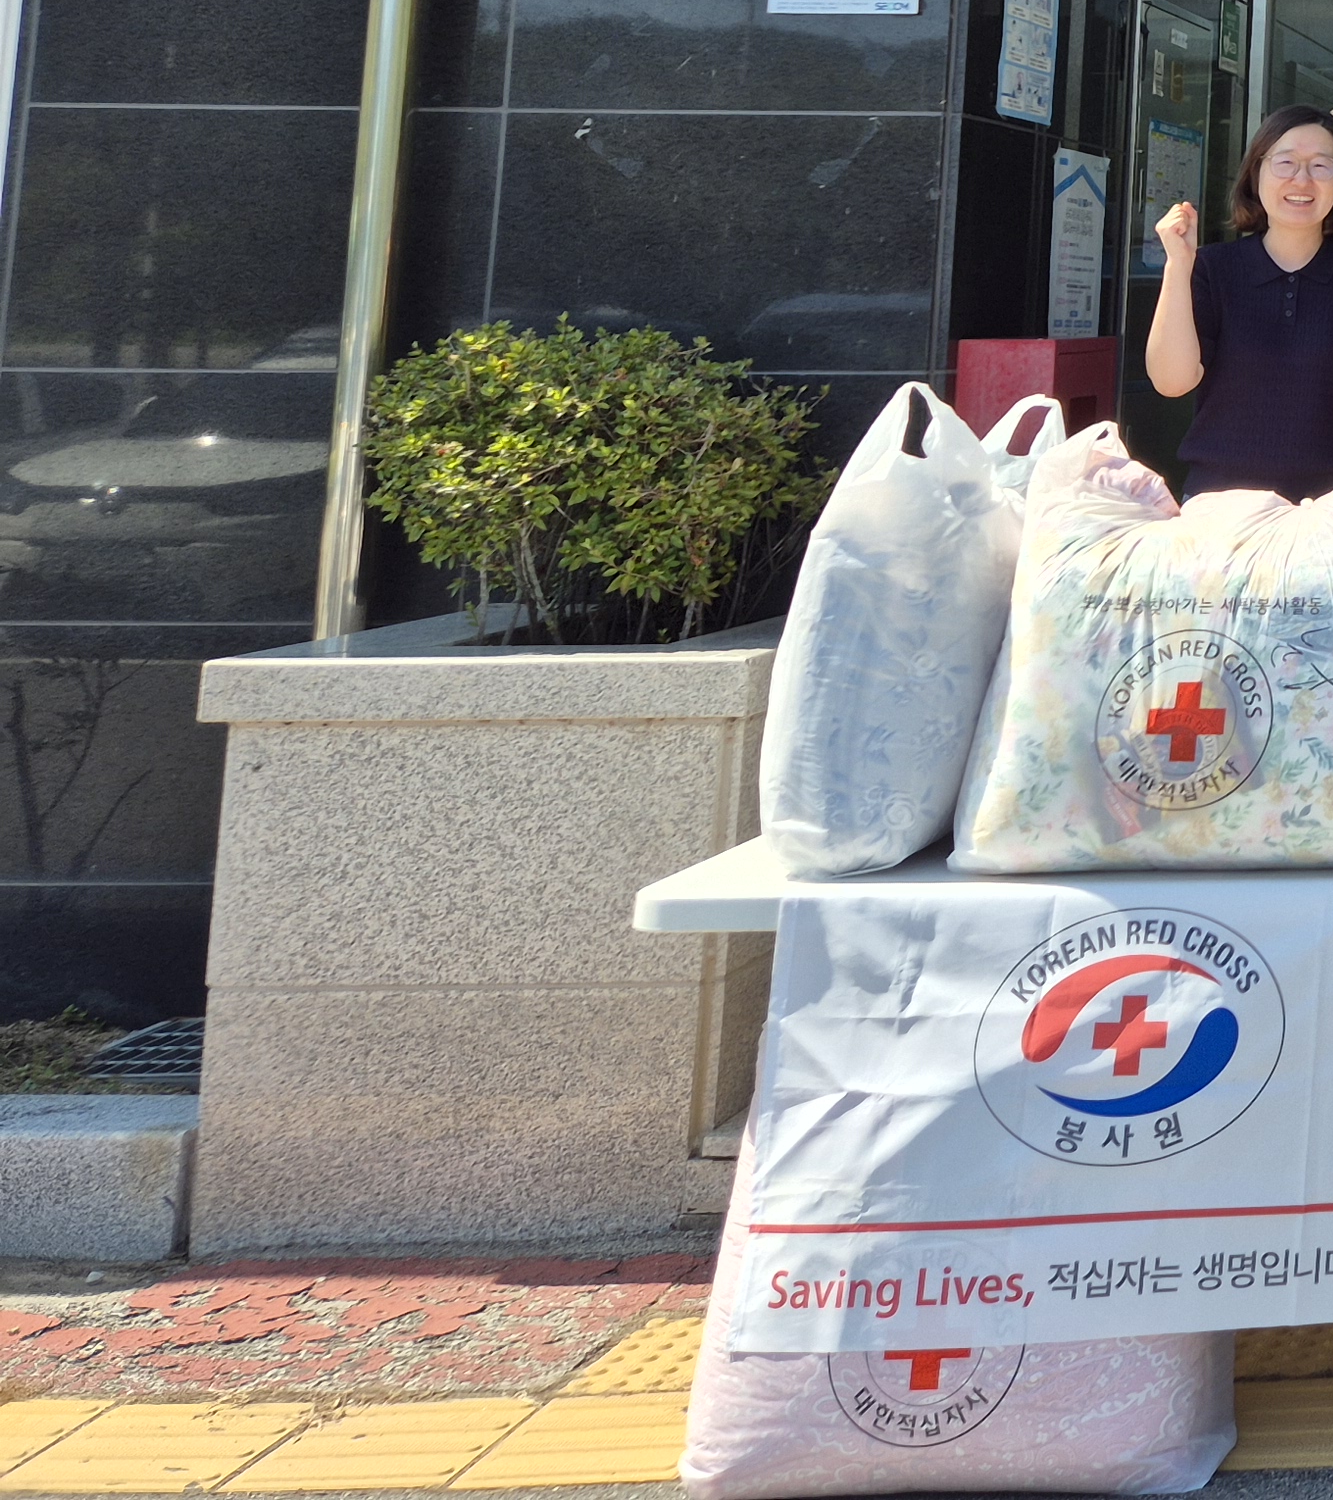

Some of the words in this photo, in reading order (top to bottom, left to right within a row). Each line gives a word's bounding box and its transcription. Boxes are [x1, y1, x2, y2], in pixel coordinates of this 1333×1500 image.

[1107, 644, 1174, 720] KOREAN
[1179, 640, 1221, 660] RED
[1222, 654, 1262, 720] CROSS
[1010, 923, 1117, 1004] KOREAN
[1125, 919, 1178, 946] RED
[1182, 925, 1261, 995] CROSS
[1055, 1111, 1185, 1159] 봉사원
[767, 1267, 902, 1320] Saving
[915, 1265, 1037, 1309] Lives,
[1047, 1256, 1185, 1302] 적십자는
[852, 1384, 992, 1439] 대한적십자사
